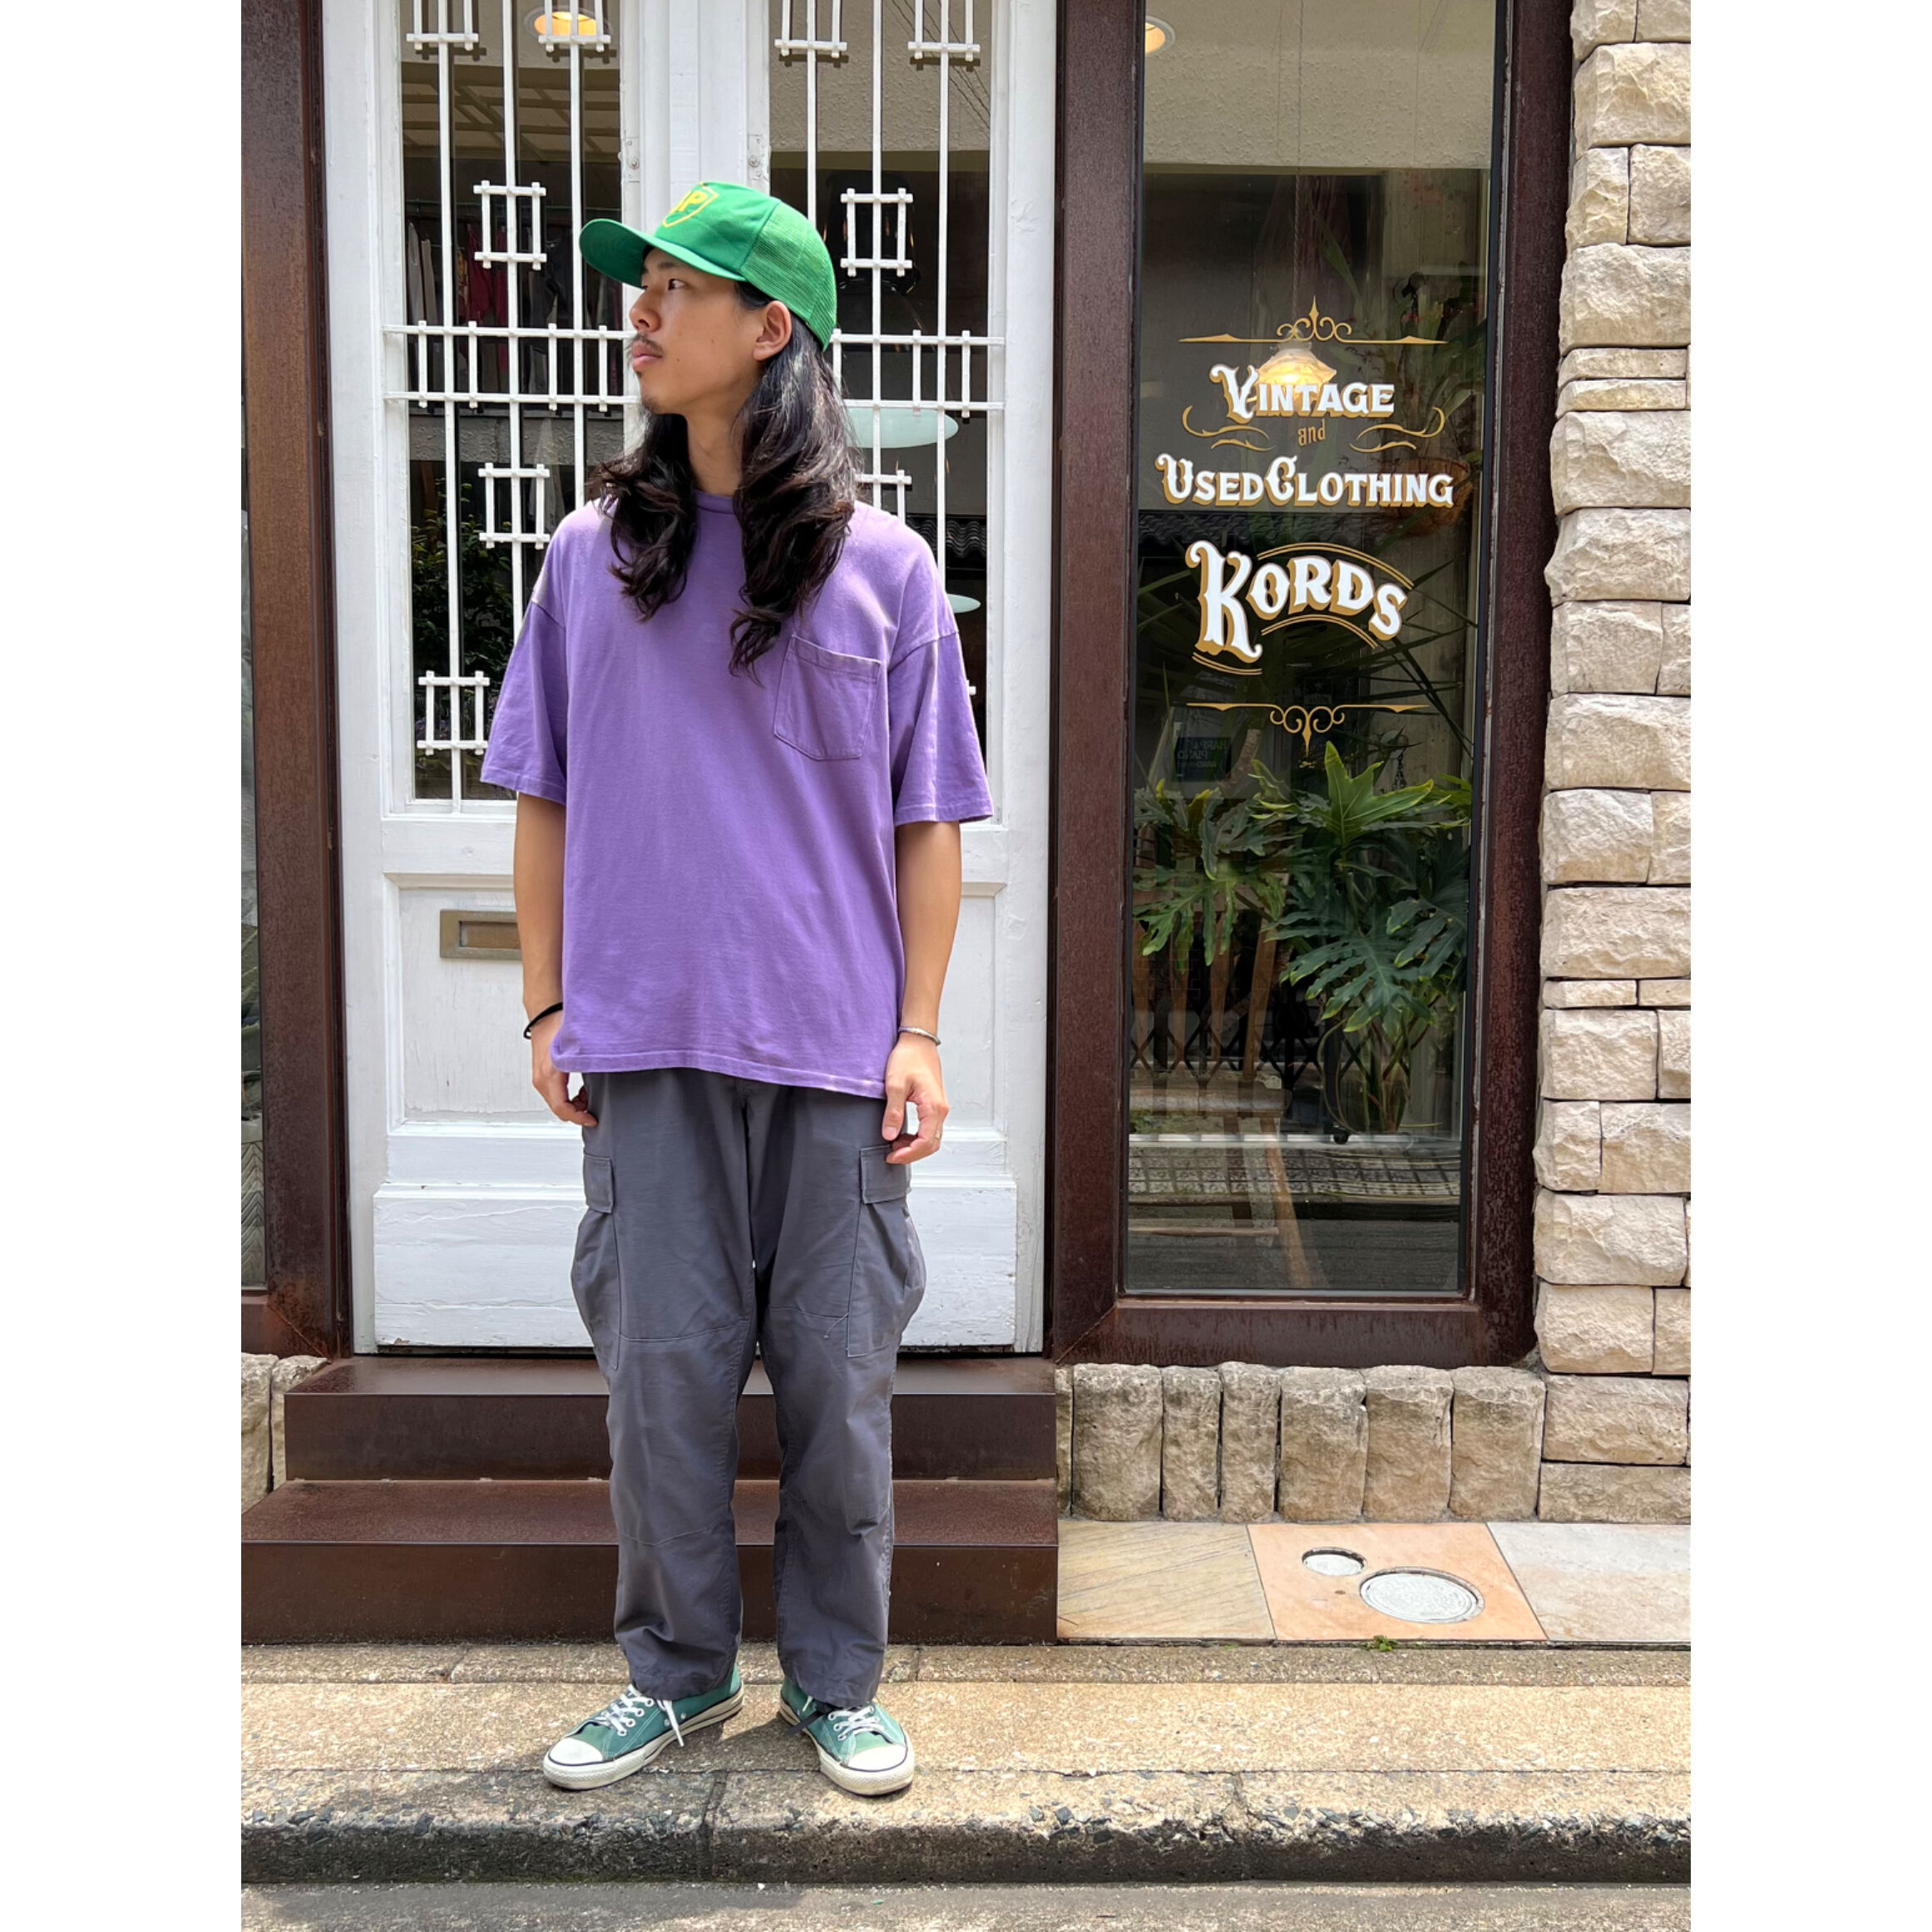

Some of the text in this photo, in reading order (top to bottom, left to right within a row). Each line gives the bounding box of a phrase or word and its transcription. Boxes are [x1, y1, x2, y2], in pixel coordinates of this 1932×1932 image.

[1210, 363, 1396, 422] VINTAGE
[1297, 419, 1326, 446] and
[1185, 540, 1408, 663] KORDS
